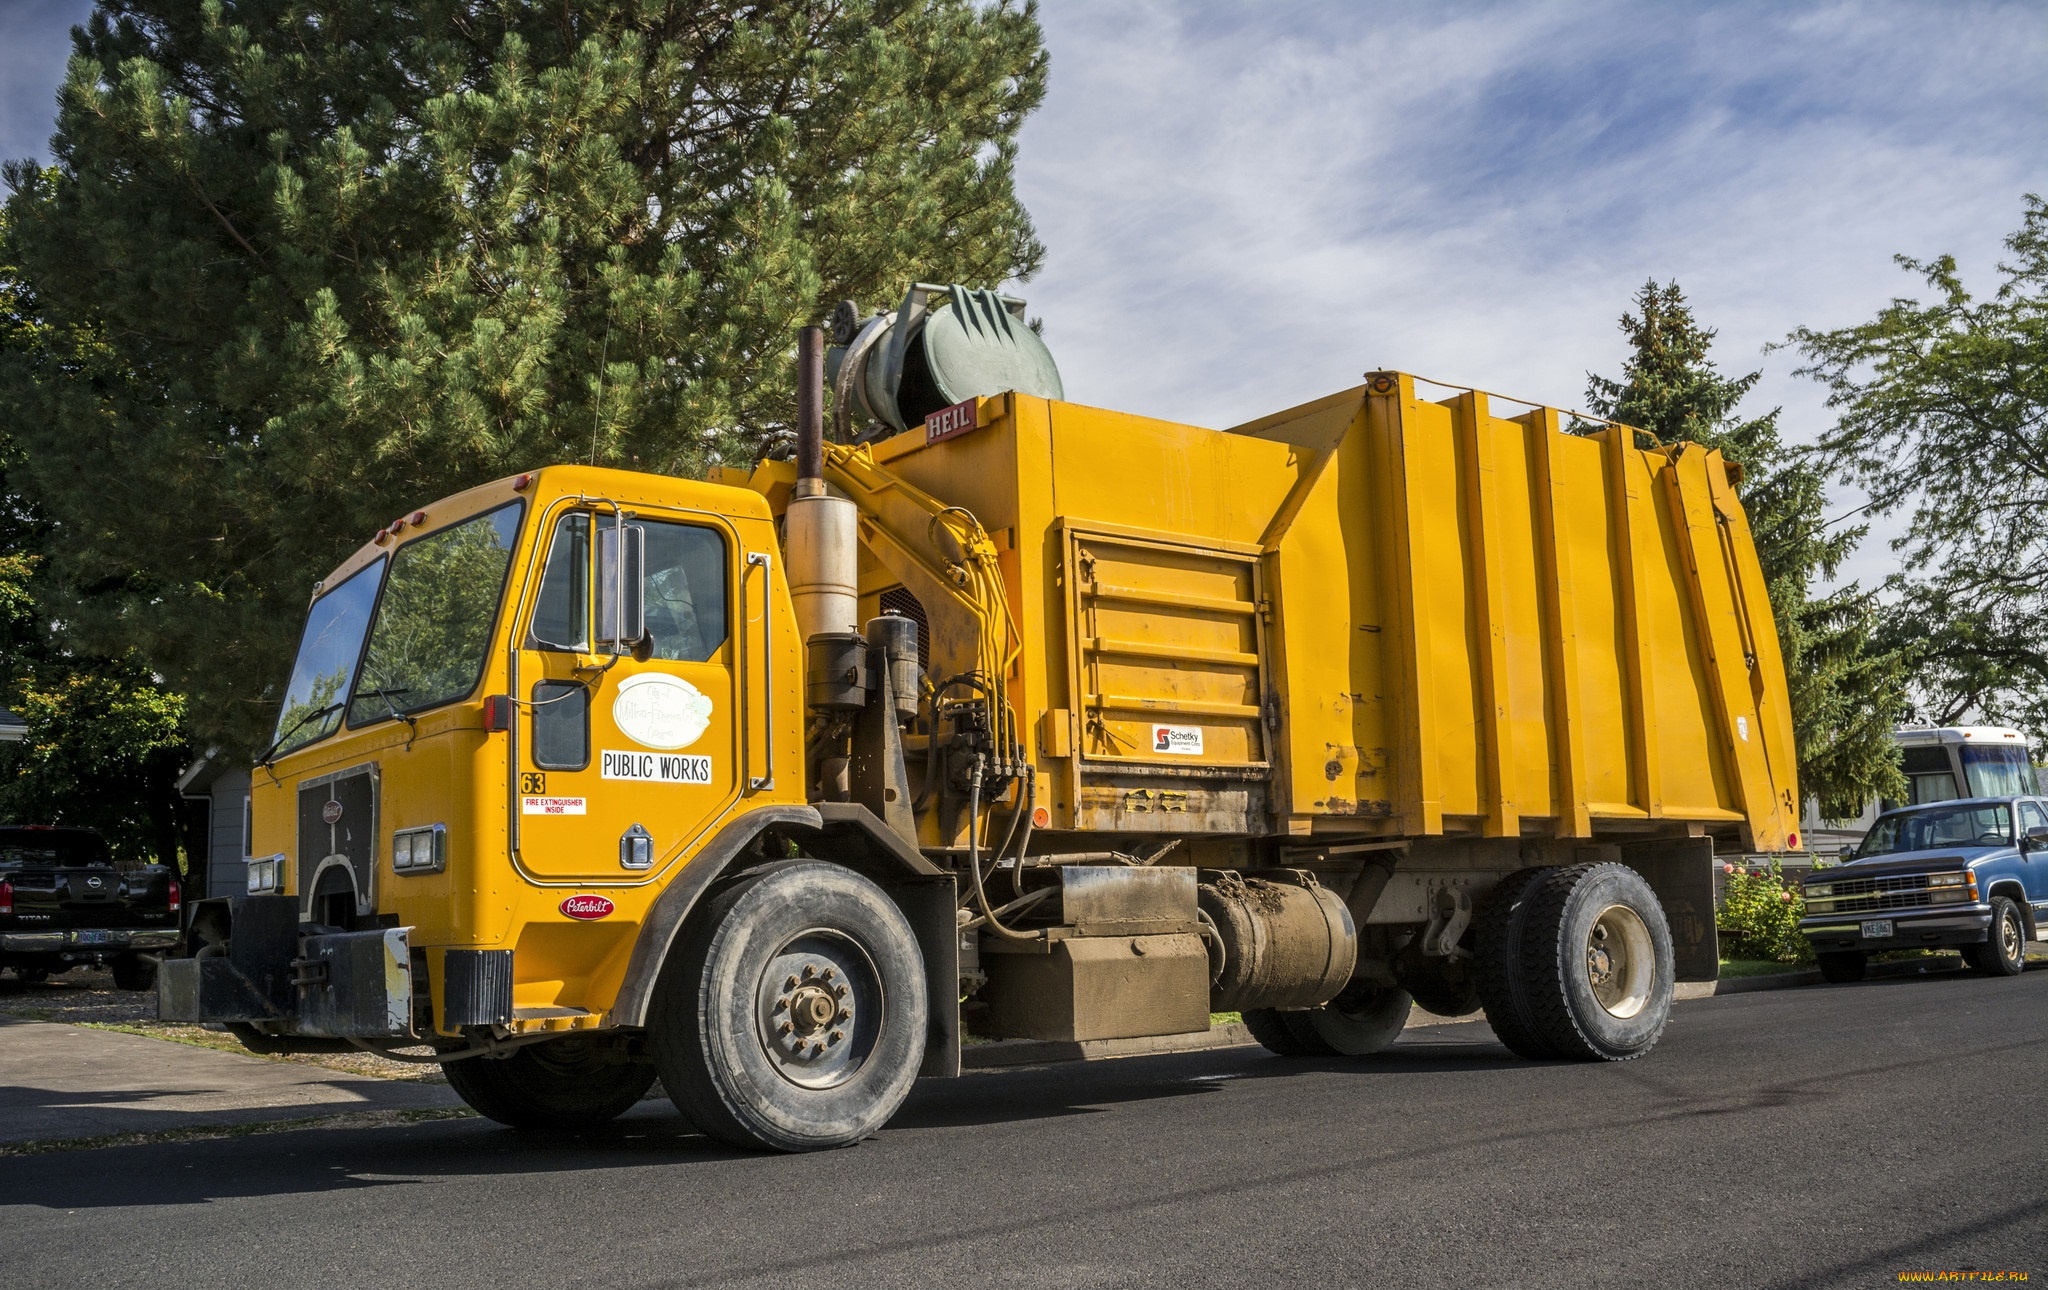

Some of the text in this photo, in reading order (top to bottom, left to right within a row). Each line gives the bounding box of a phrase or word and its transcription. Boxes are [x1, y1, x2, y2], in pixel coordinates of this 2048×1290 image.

[929, 406, 970, 438] HEIL
[1170, 731, 1198, 742] Schetky
[604, 753, 709, 781] PUBLIC WORKS
[521, 773, 545, 793] 63
[525, 798, 583, 807] FIRE EXTINGUISHER
[567, 899, 610, 913] Peterbilt
[1863, 924, 1876, 935] VKE
